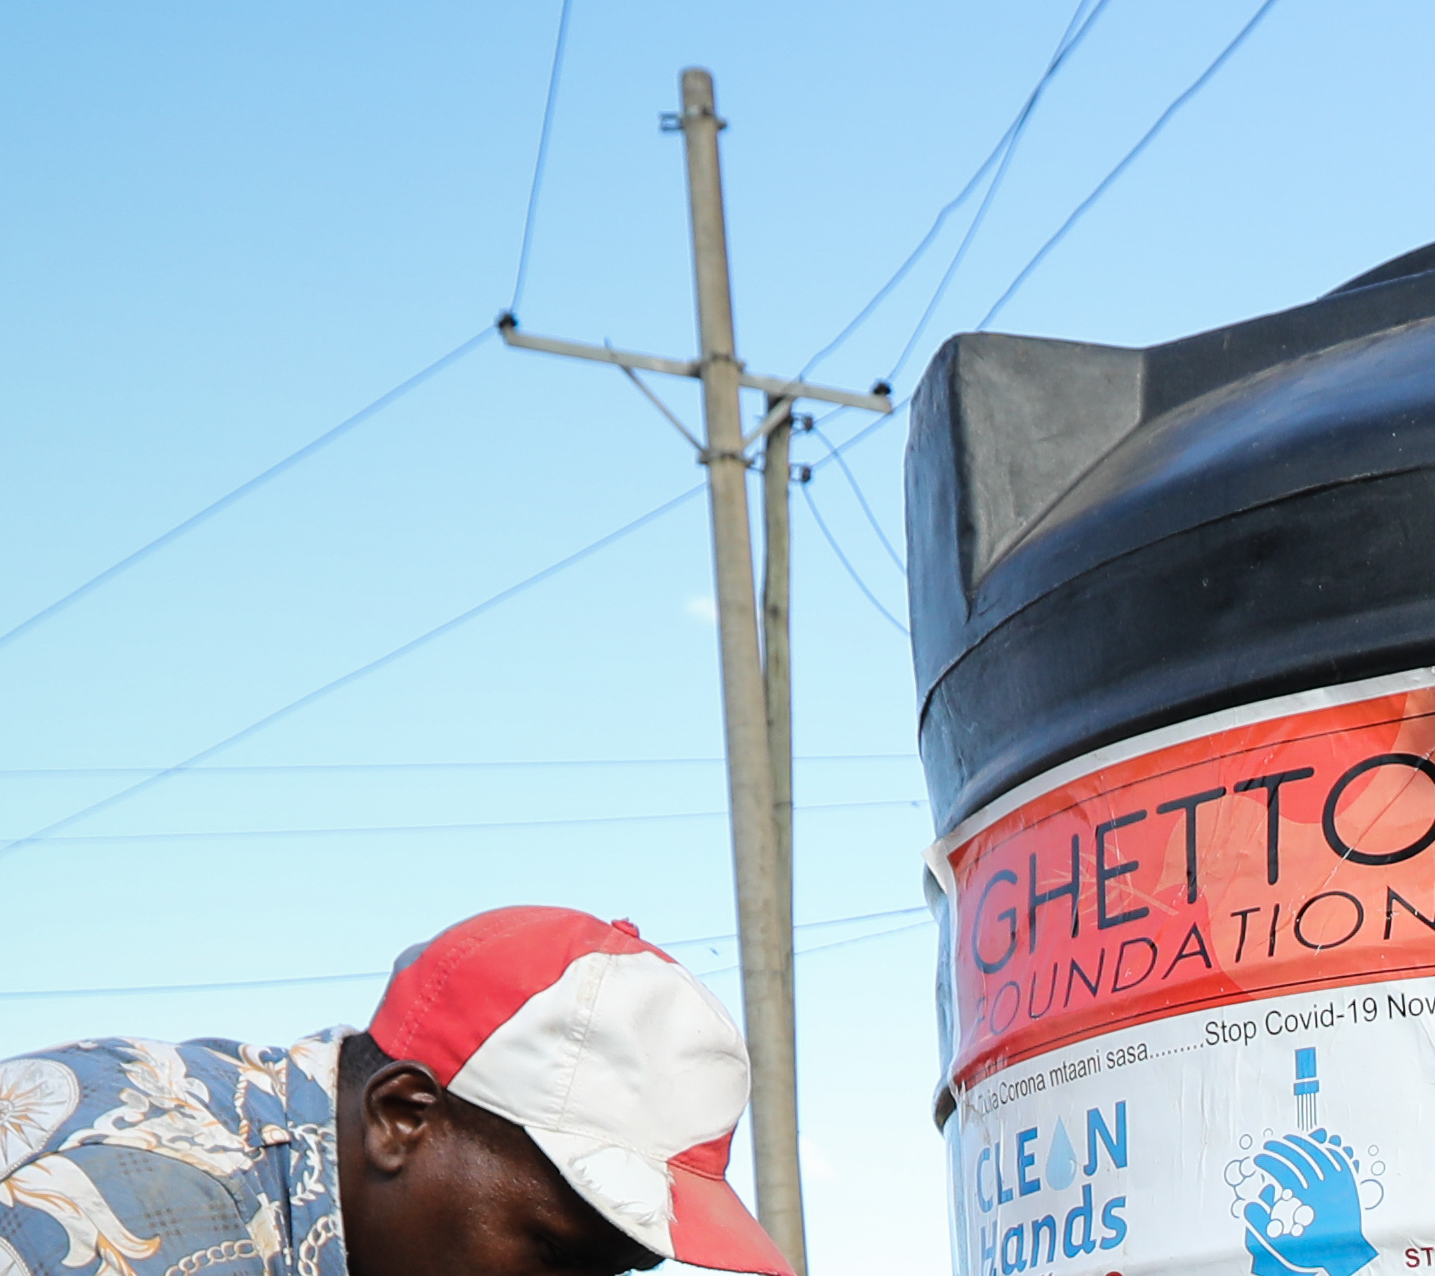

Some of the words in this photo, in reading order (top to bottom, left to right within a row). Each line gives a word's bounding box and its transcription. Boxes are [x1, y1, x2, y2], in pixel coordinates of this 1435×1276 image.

[999, 1074, 1046, 1105] Corona
[1049, 1049, 1102, 1087] mtaani
[1264, 995, 1379, 1034] Covid-19
